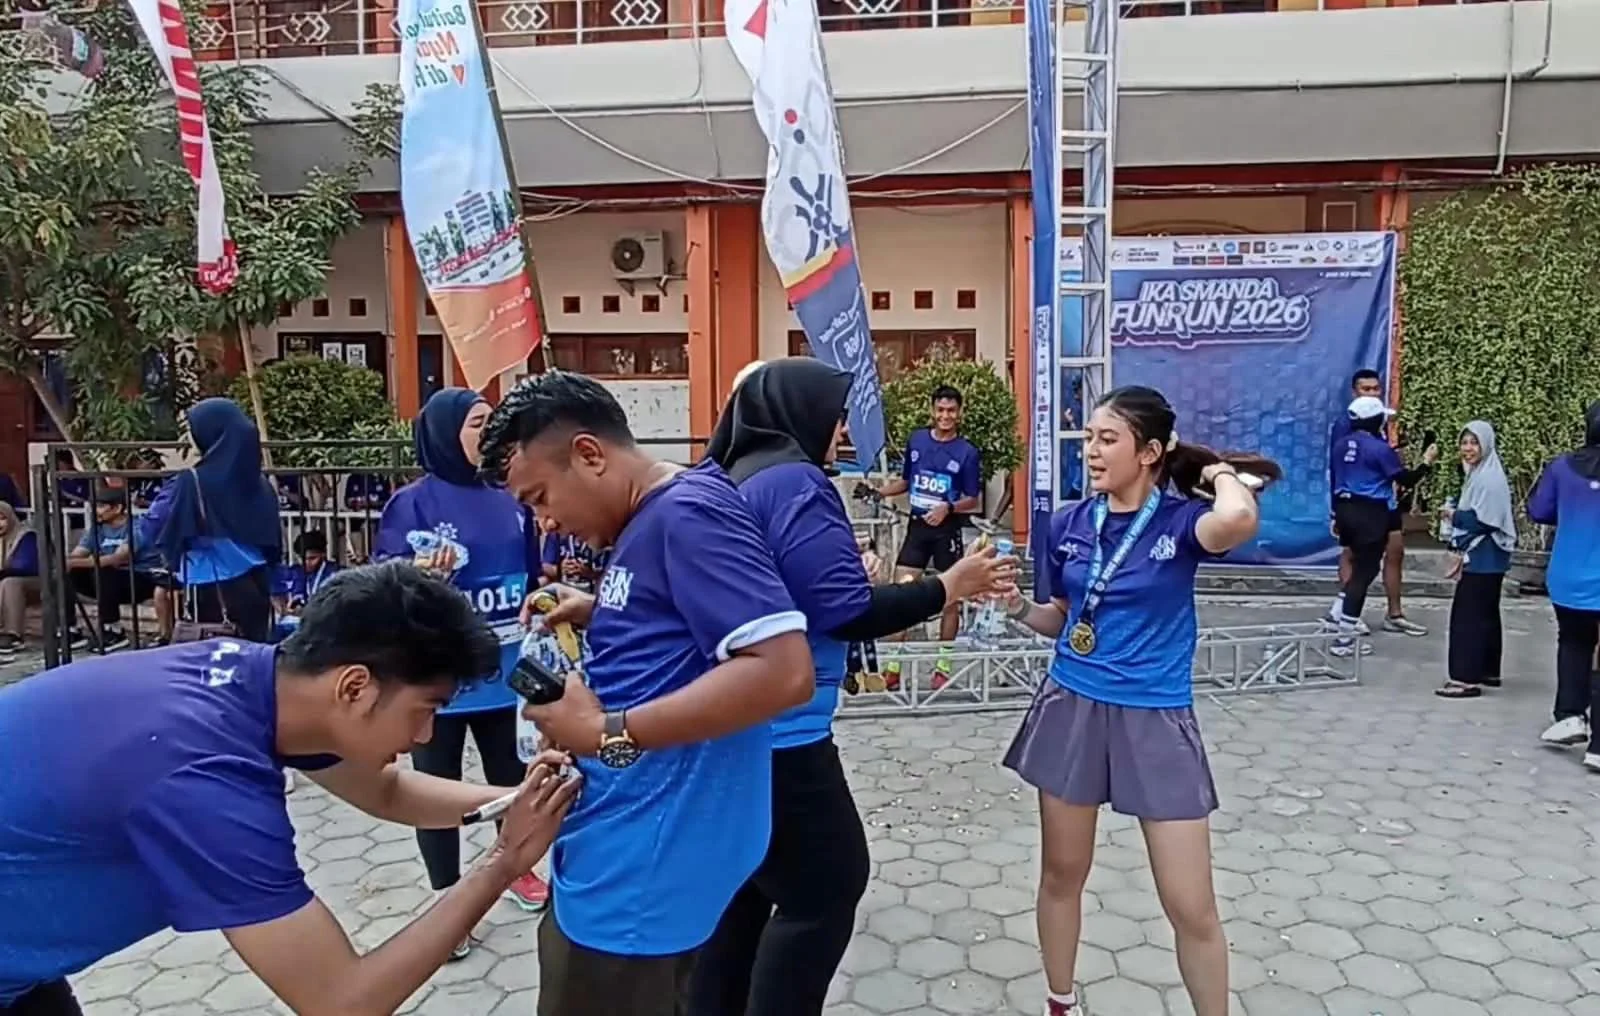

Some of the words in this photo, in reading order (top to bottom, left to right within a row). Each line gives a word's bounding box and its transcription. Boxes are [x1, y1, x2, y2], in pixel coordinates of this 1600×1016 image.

[1140, 280, 1176, 302] IKA
[1179, 279, 1274, 302] SMANDA
[1110, 301, 1231, 333] FUNRUN
[1229, 295, 1303, 326] 2026
[913, 474, 947, 494] 1305
